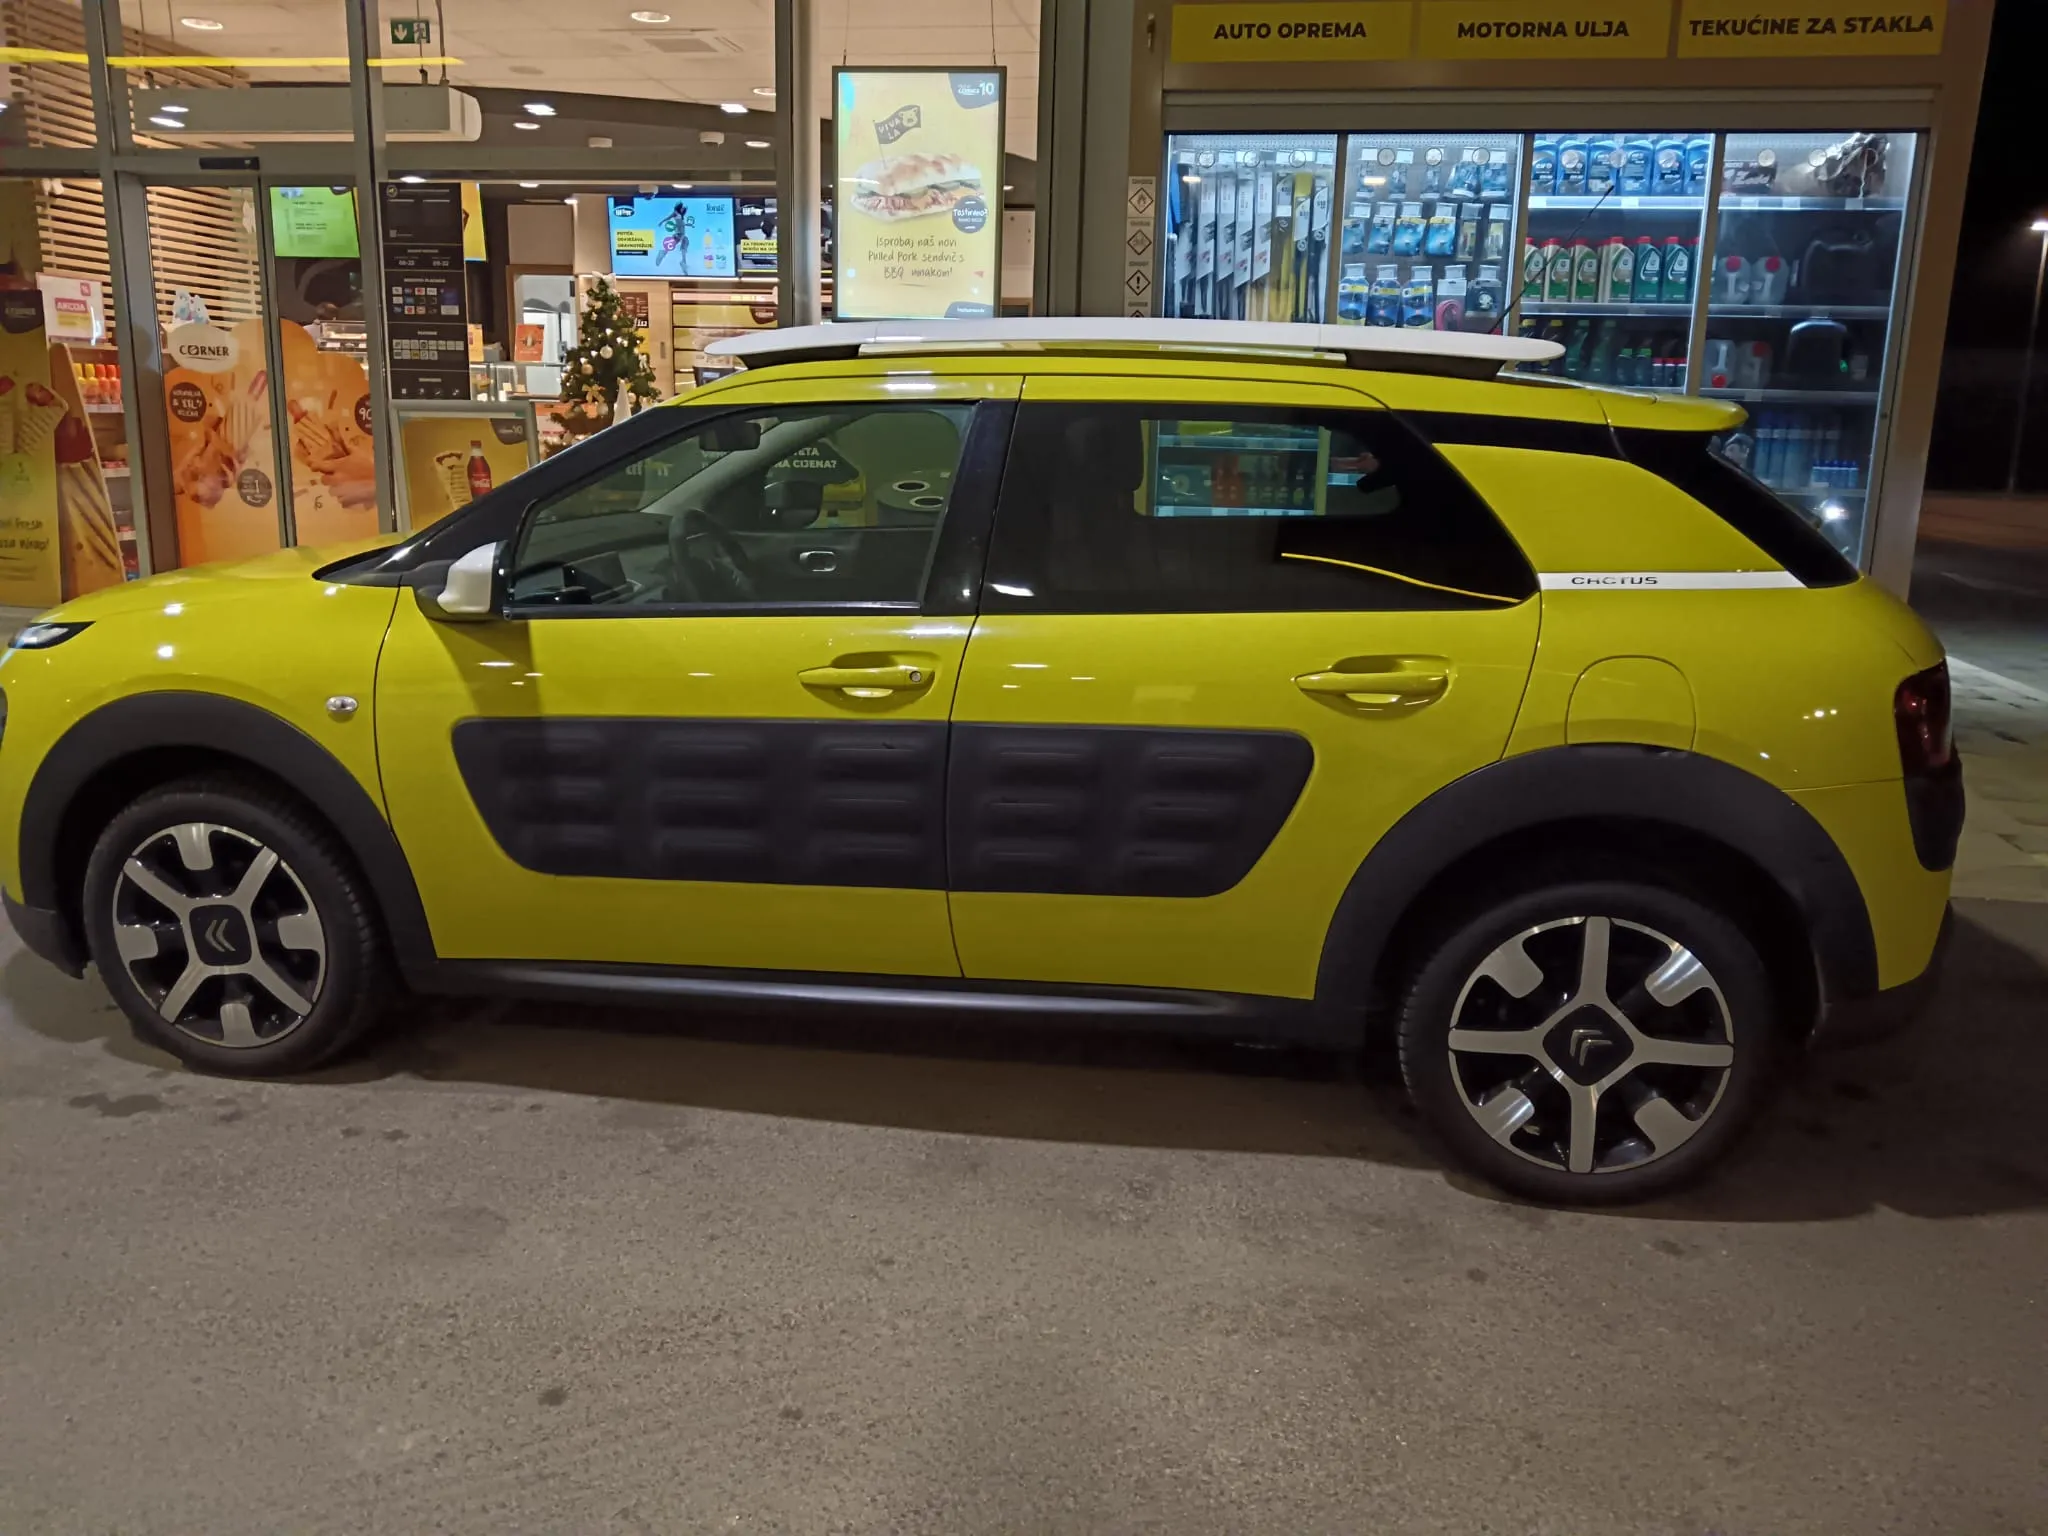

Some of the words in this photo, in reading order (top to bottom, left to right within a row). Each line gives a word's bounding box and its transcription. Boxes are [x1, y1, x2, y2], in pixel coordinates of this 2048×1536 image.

[1213, 22, 1271, 39] AUTO
[1277, 21, 1367, 39] OPREMA
[1457, 20, 1568, 38] MOTORNA
[1574, 20, 1629, 37] ULJA
[1688, 14, 1800, 36] TEKUĆINE
[1805, 17, 1837, 35] ZA
[1843, 14, 1934, 34] STAKLA
[979, 82, 995, 96] 10
[878, 117, 901, 134] VIVA
[887, 128, 900, 140] LA
[876, 235, 914, 248] Isprobaj
[917, 235, 935, 247] naš
[938, 238, 957, 248] novi
[868, 250, 894, 261] Pulled
[897, 251, 917, 262] Pork
[921, 251, 957, 262] sendvič
[884, 266, 904, 279] BBQ
[792, 460, 837, 469] CIJENA?
[1571, 576, 1659, 585] CACTUS
